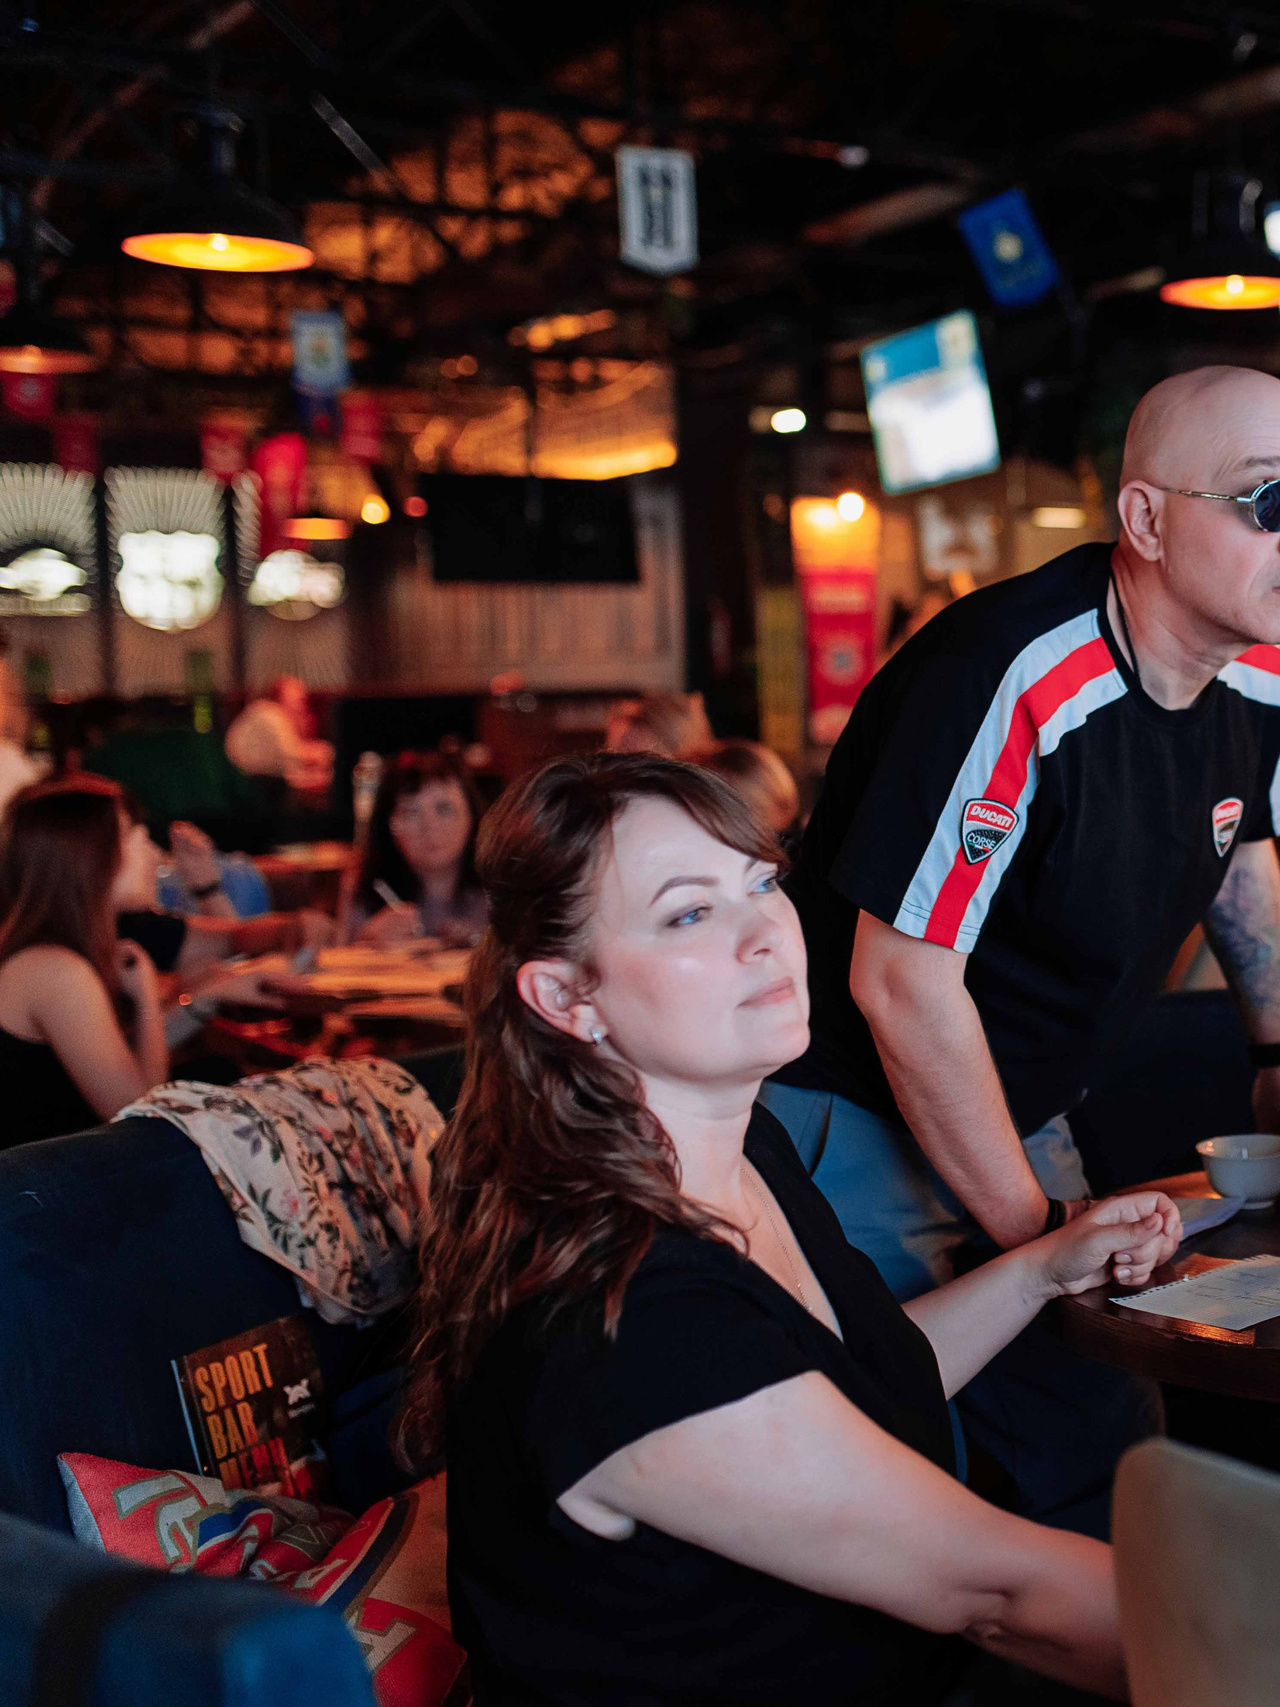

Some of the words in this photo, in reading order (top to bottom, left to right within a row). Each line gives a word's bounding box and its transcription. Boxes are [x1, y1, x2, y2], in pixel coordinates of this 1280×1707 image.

[970, 805, 1012, 827] DUCATI
[967, 832, 996, 850] CORSE
[195, 1343, 273, 1412] SPORT
[206, 1401, 259, 1459] BAR
